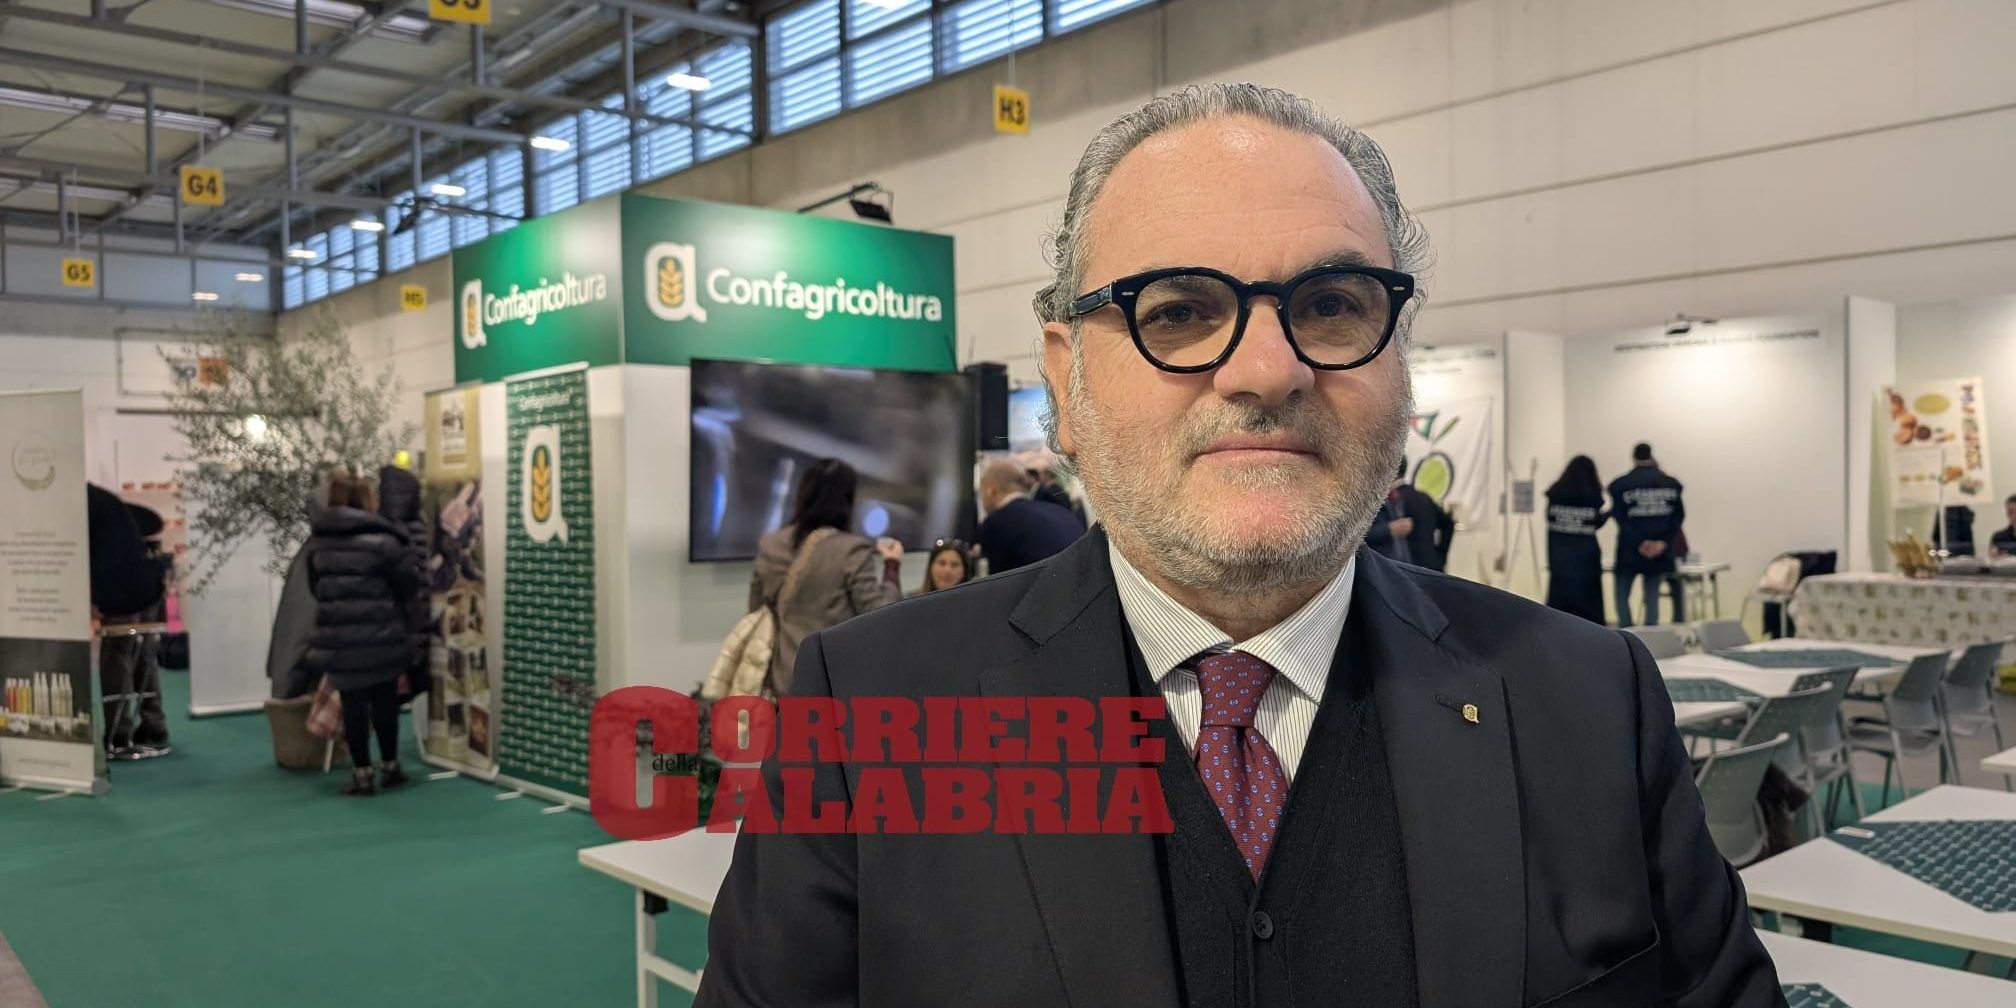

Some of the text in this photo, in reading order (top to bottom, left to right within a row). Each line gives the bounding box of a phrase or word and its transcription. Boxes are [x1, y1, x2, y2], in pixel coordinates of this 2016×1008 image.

[999, 97, 1025, 126] H3
[188, 174, 217, 197] G4
[67, 264, 90, 281] G5
[484, 269, 608, 325] Confagricoltura
[707, 268, 943, 323] Confagricoltura
